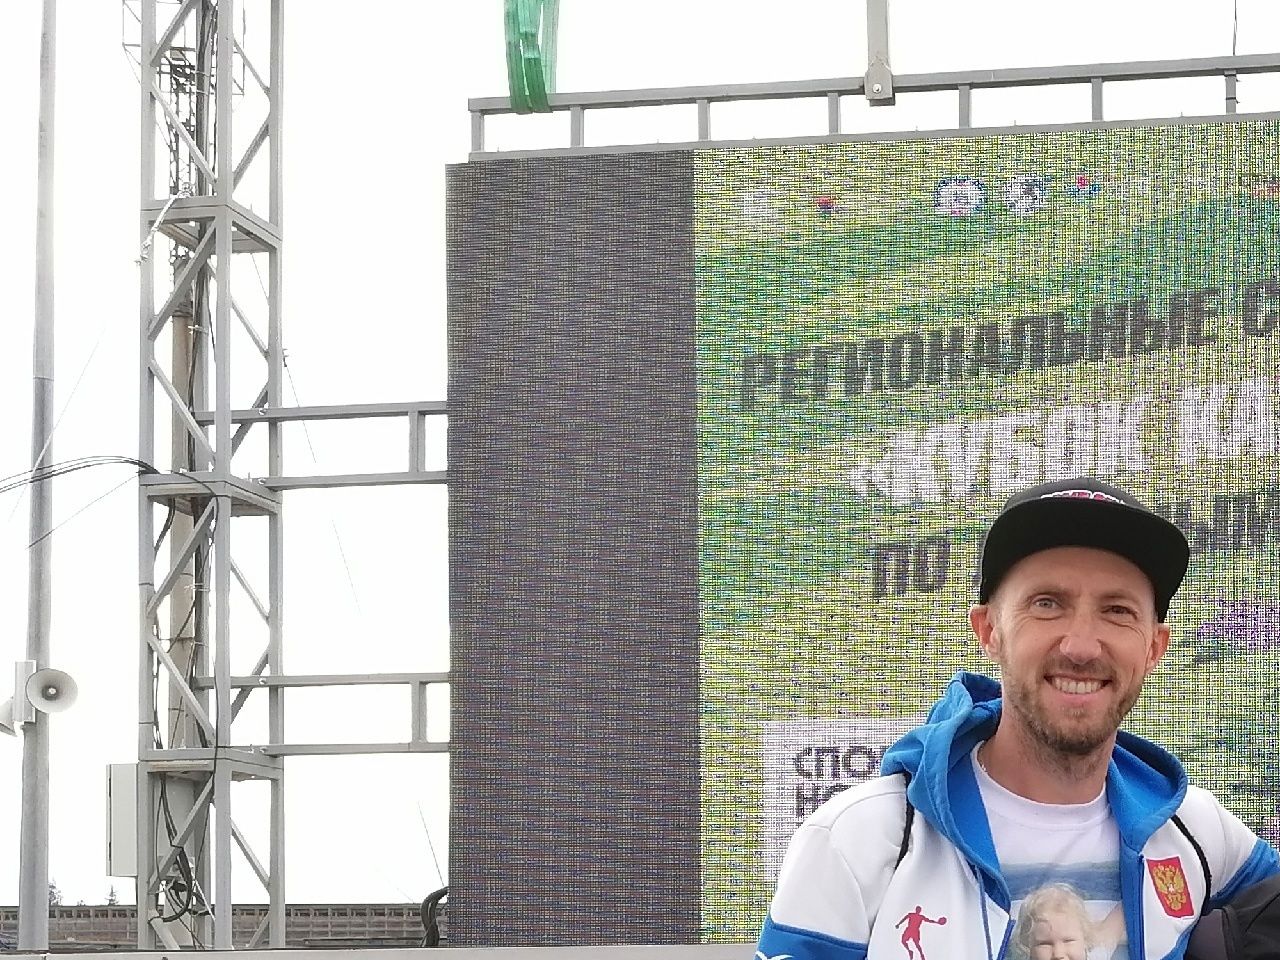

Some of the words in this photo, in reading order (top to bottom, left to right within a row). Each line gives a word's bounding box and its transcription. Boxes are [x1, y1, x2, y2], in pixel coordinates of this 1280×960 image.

[740, 288, 1219, 410] РЕГИОНАЛЬНЫЕ
[872, 536, 950, 599] ПО
[794, 746, 887, 780] СПО
